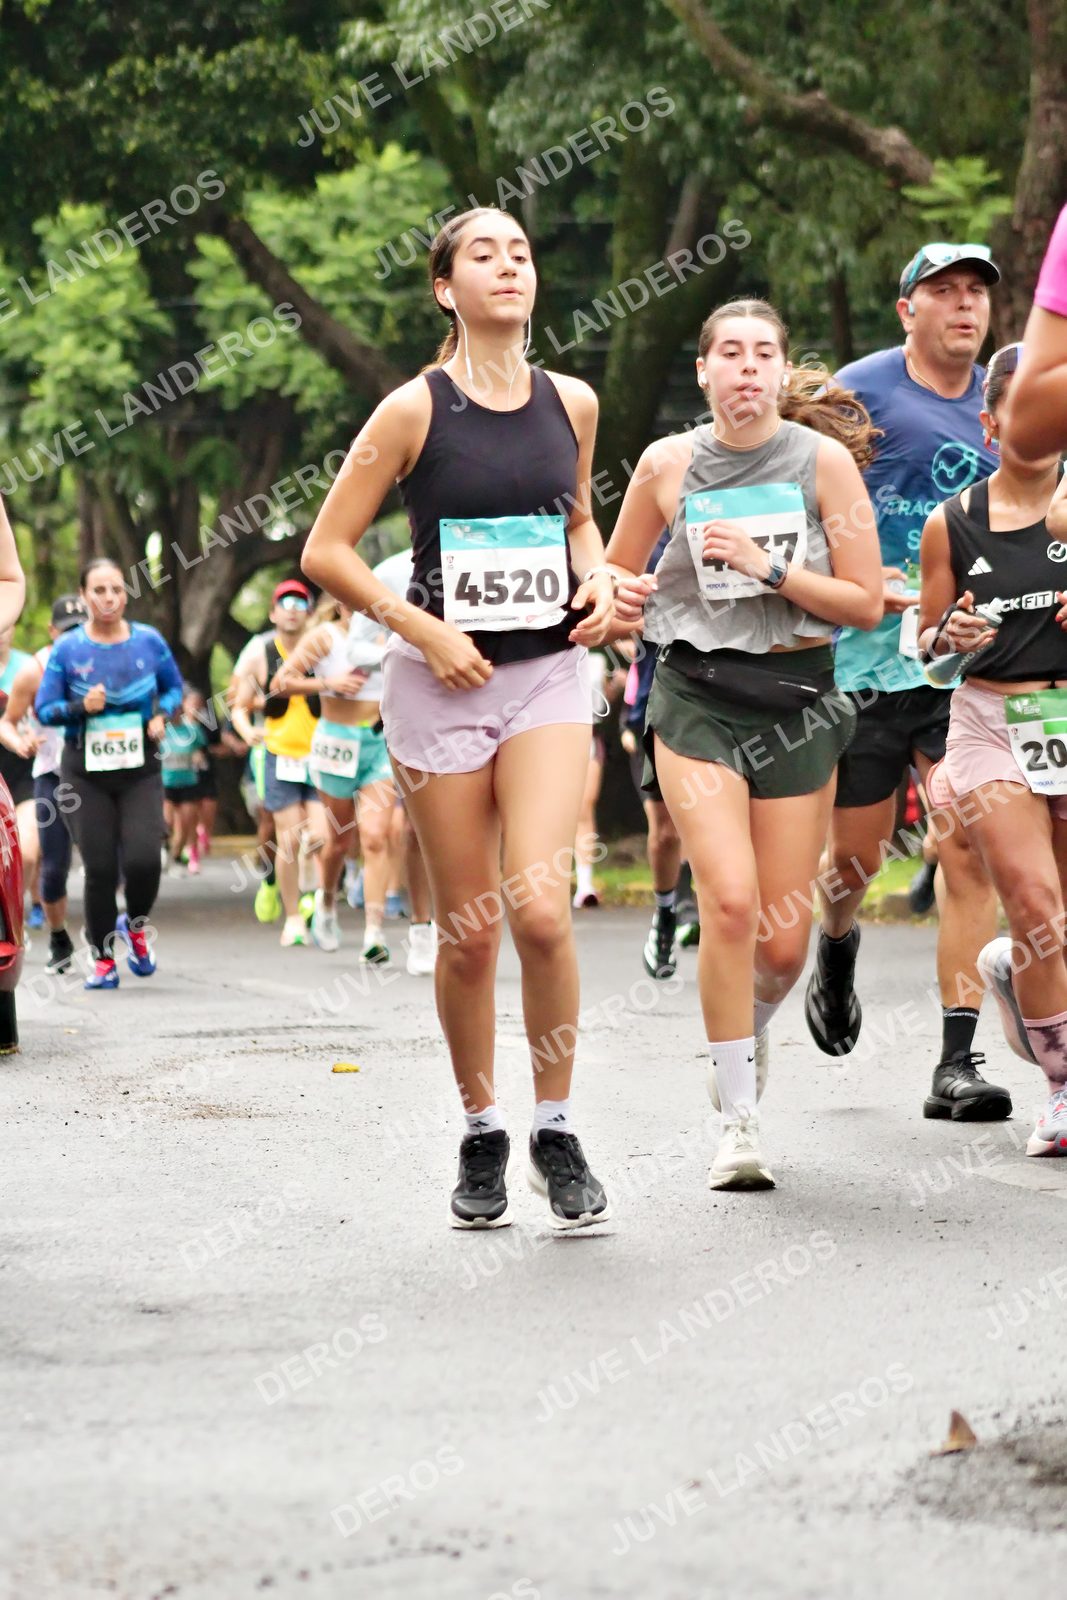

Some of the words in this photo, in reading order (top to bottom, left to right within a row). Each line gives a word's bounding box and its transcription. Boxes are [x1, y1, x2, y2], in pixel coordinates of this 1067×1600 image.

[887, 500, 939, 516] TRAC
[455, 568, 560, 607] 4520
[1024, 593, 1050, 608] FIT
[92, 738, 138, 756] 6636
